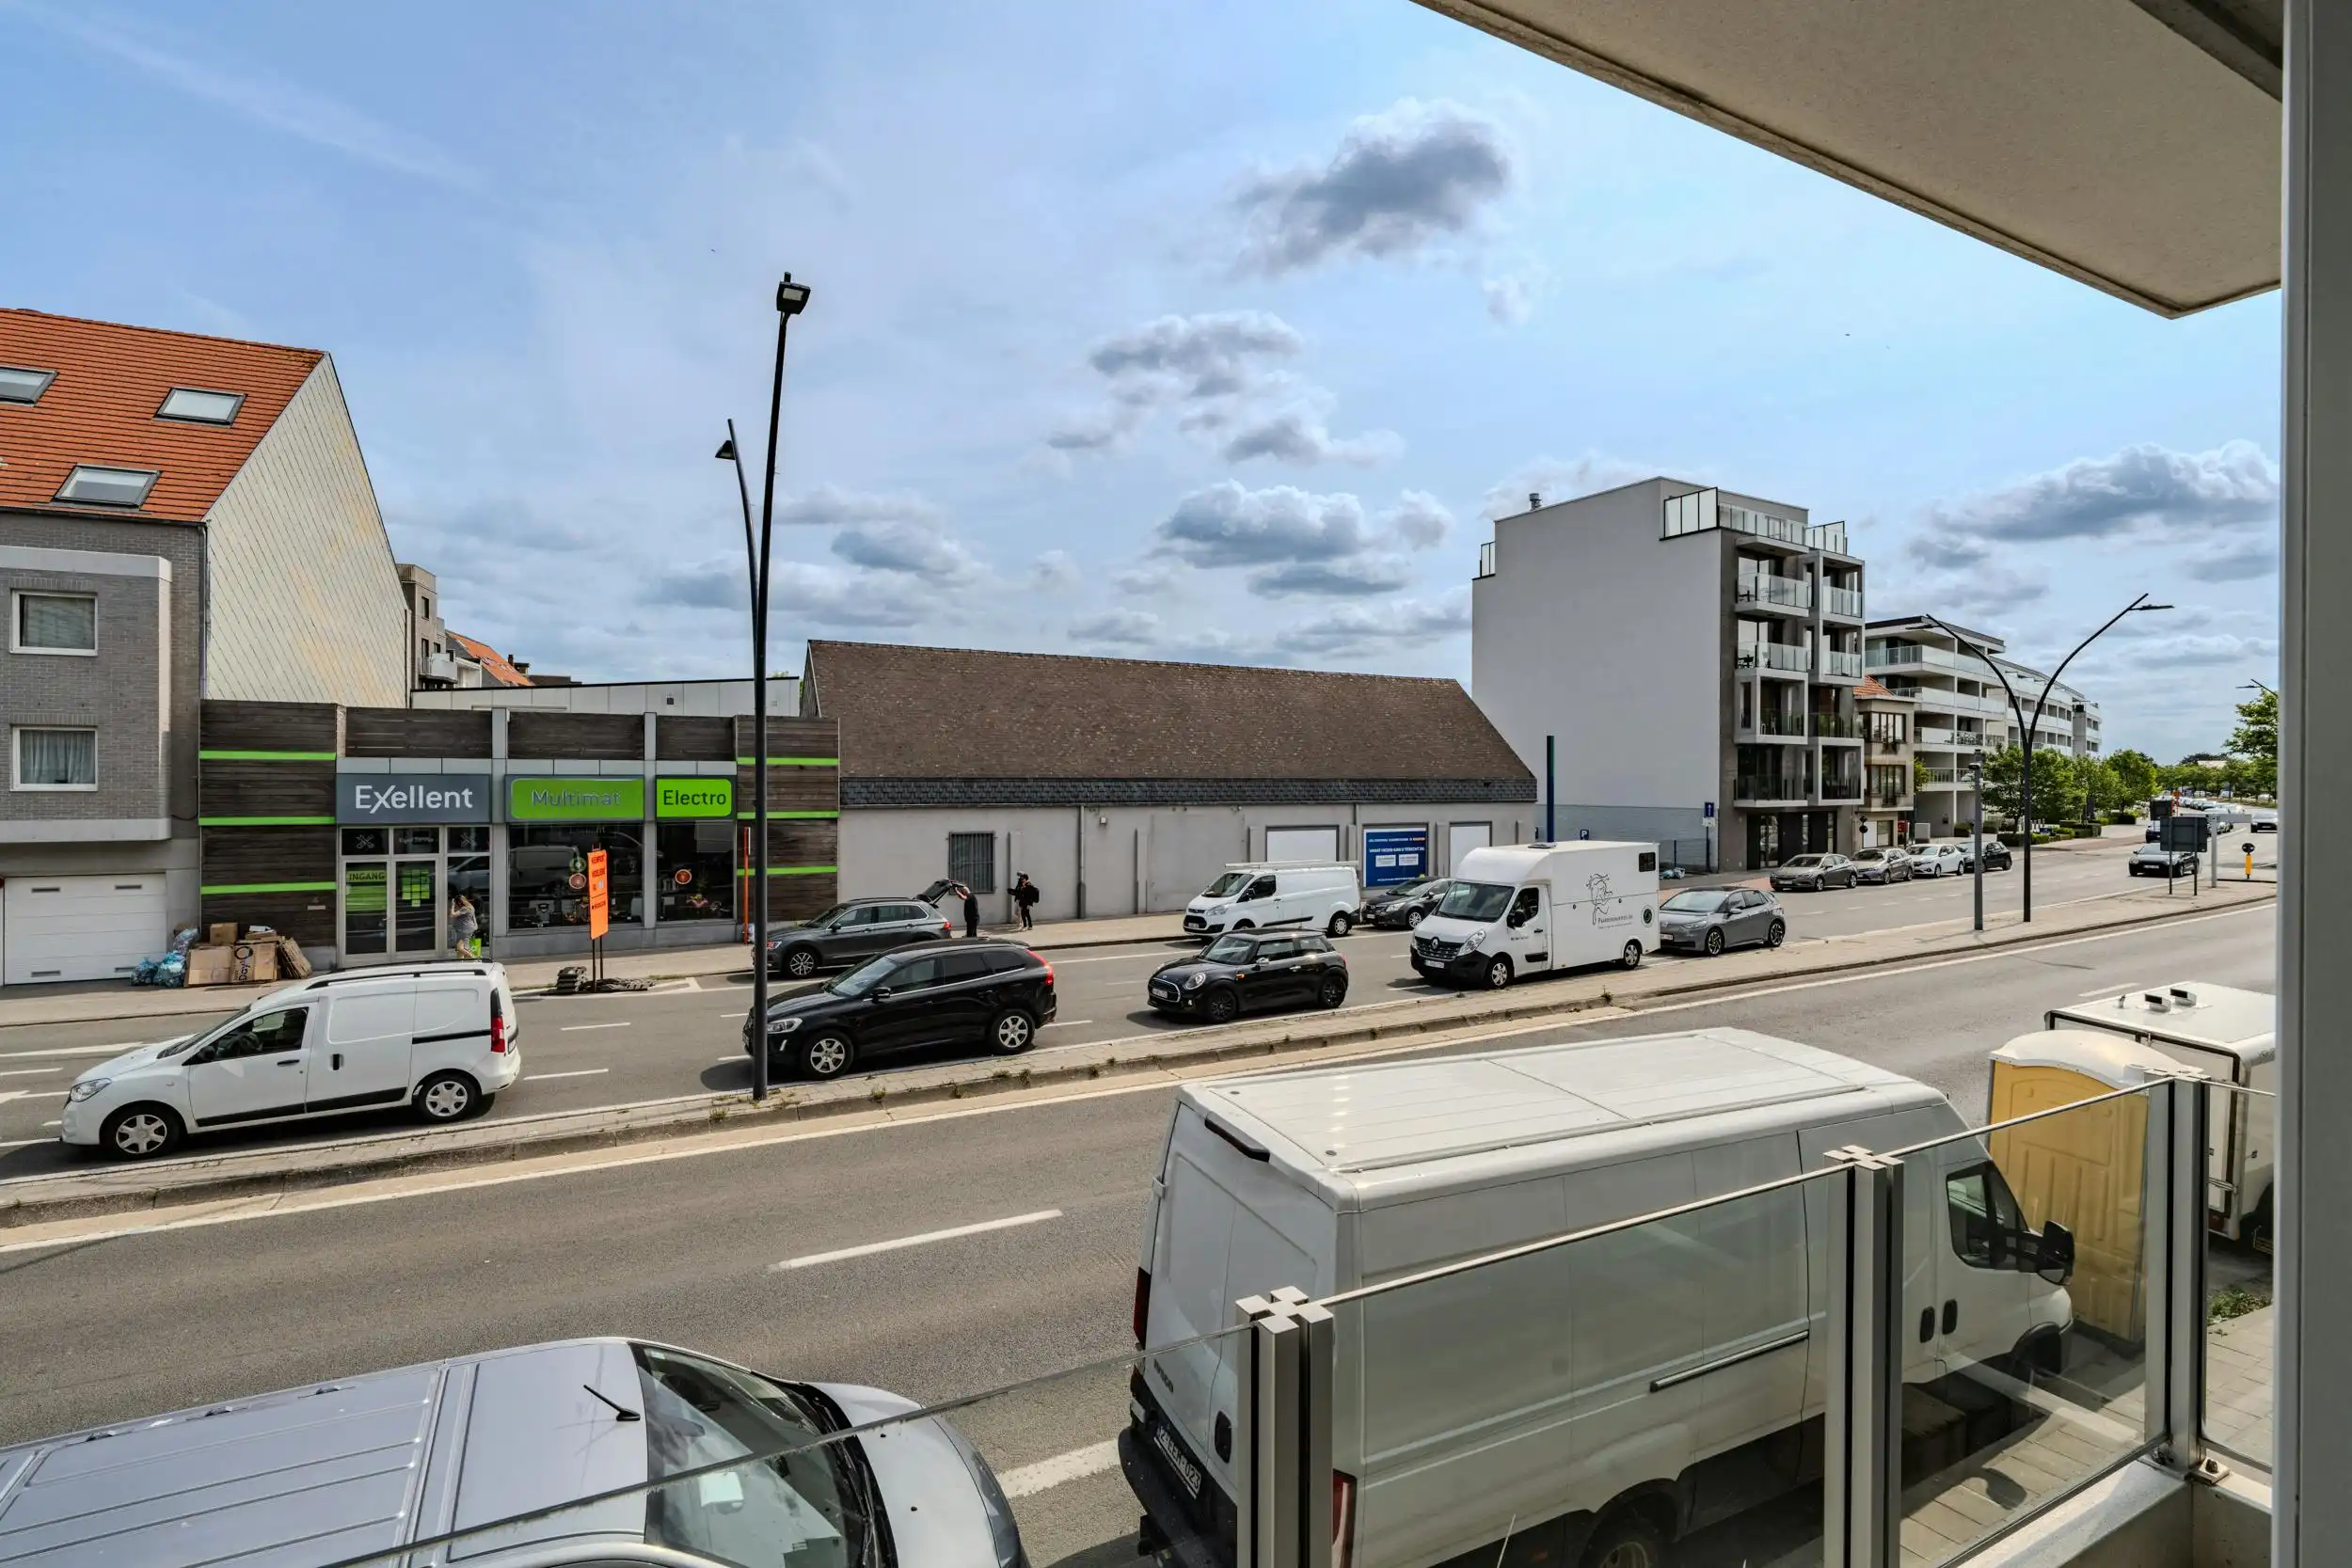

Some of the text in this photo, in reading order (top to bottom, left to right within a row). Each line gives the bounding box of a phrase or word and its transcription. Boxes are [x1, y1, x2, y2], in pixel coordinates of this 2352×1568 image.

[532, 789, 621, 806] Multimat
[663, 789, 727, 806] Electro
[349, 871, 386, 881] INGANG
